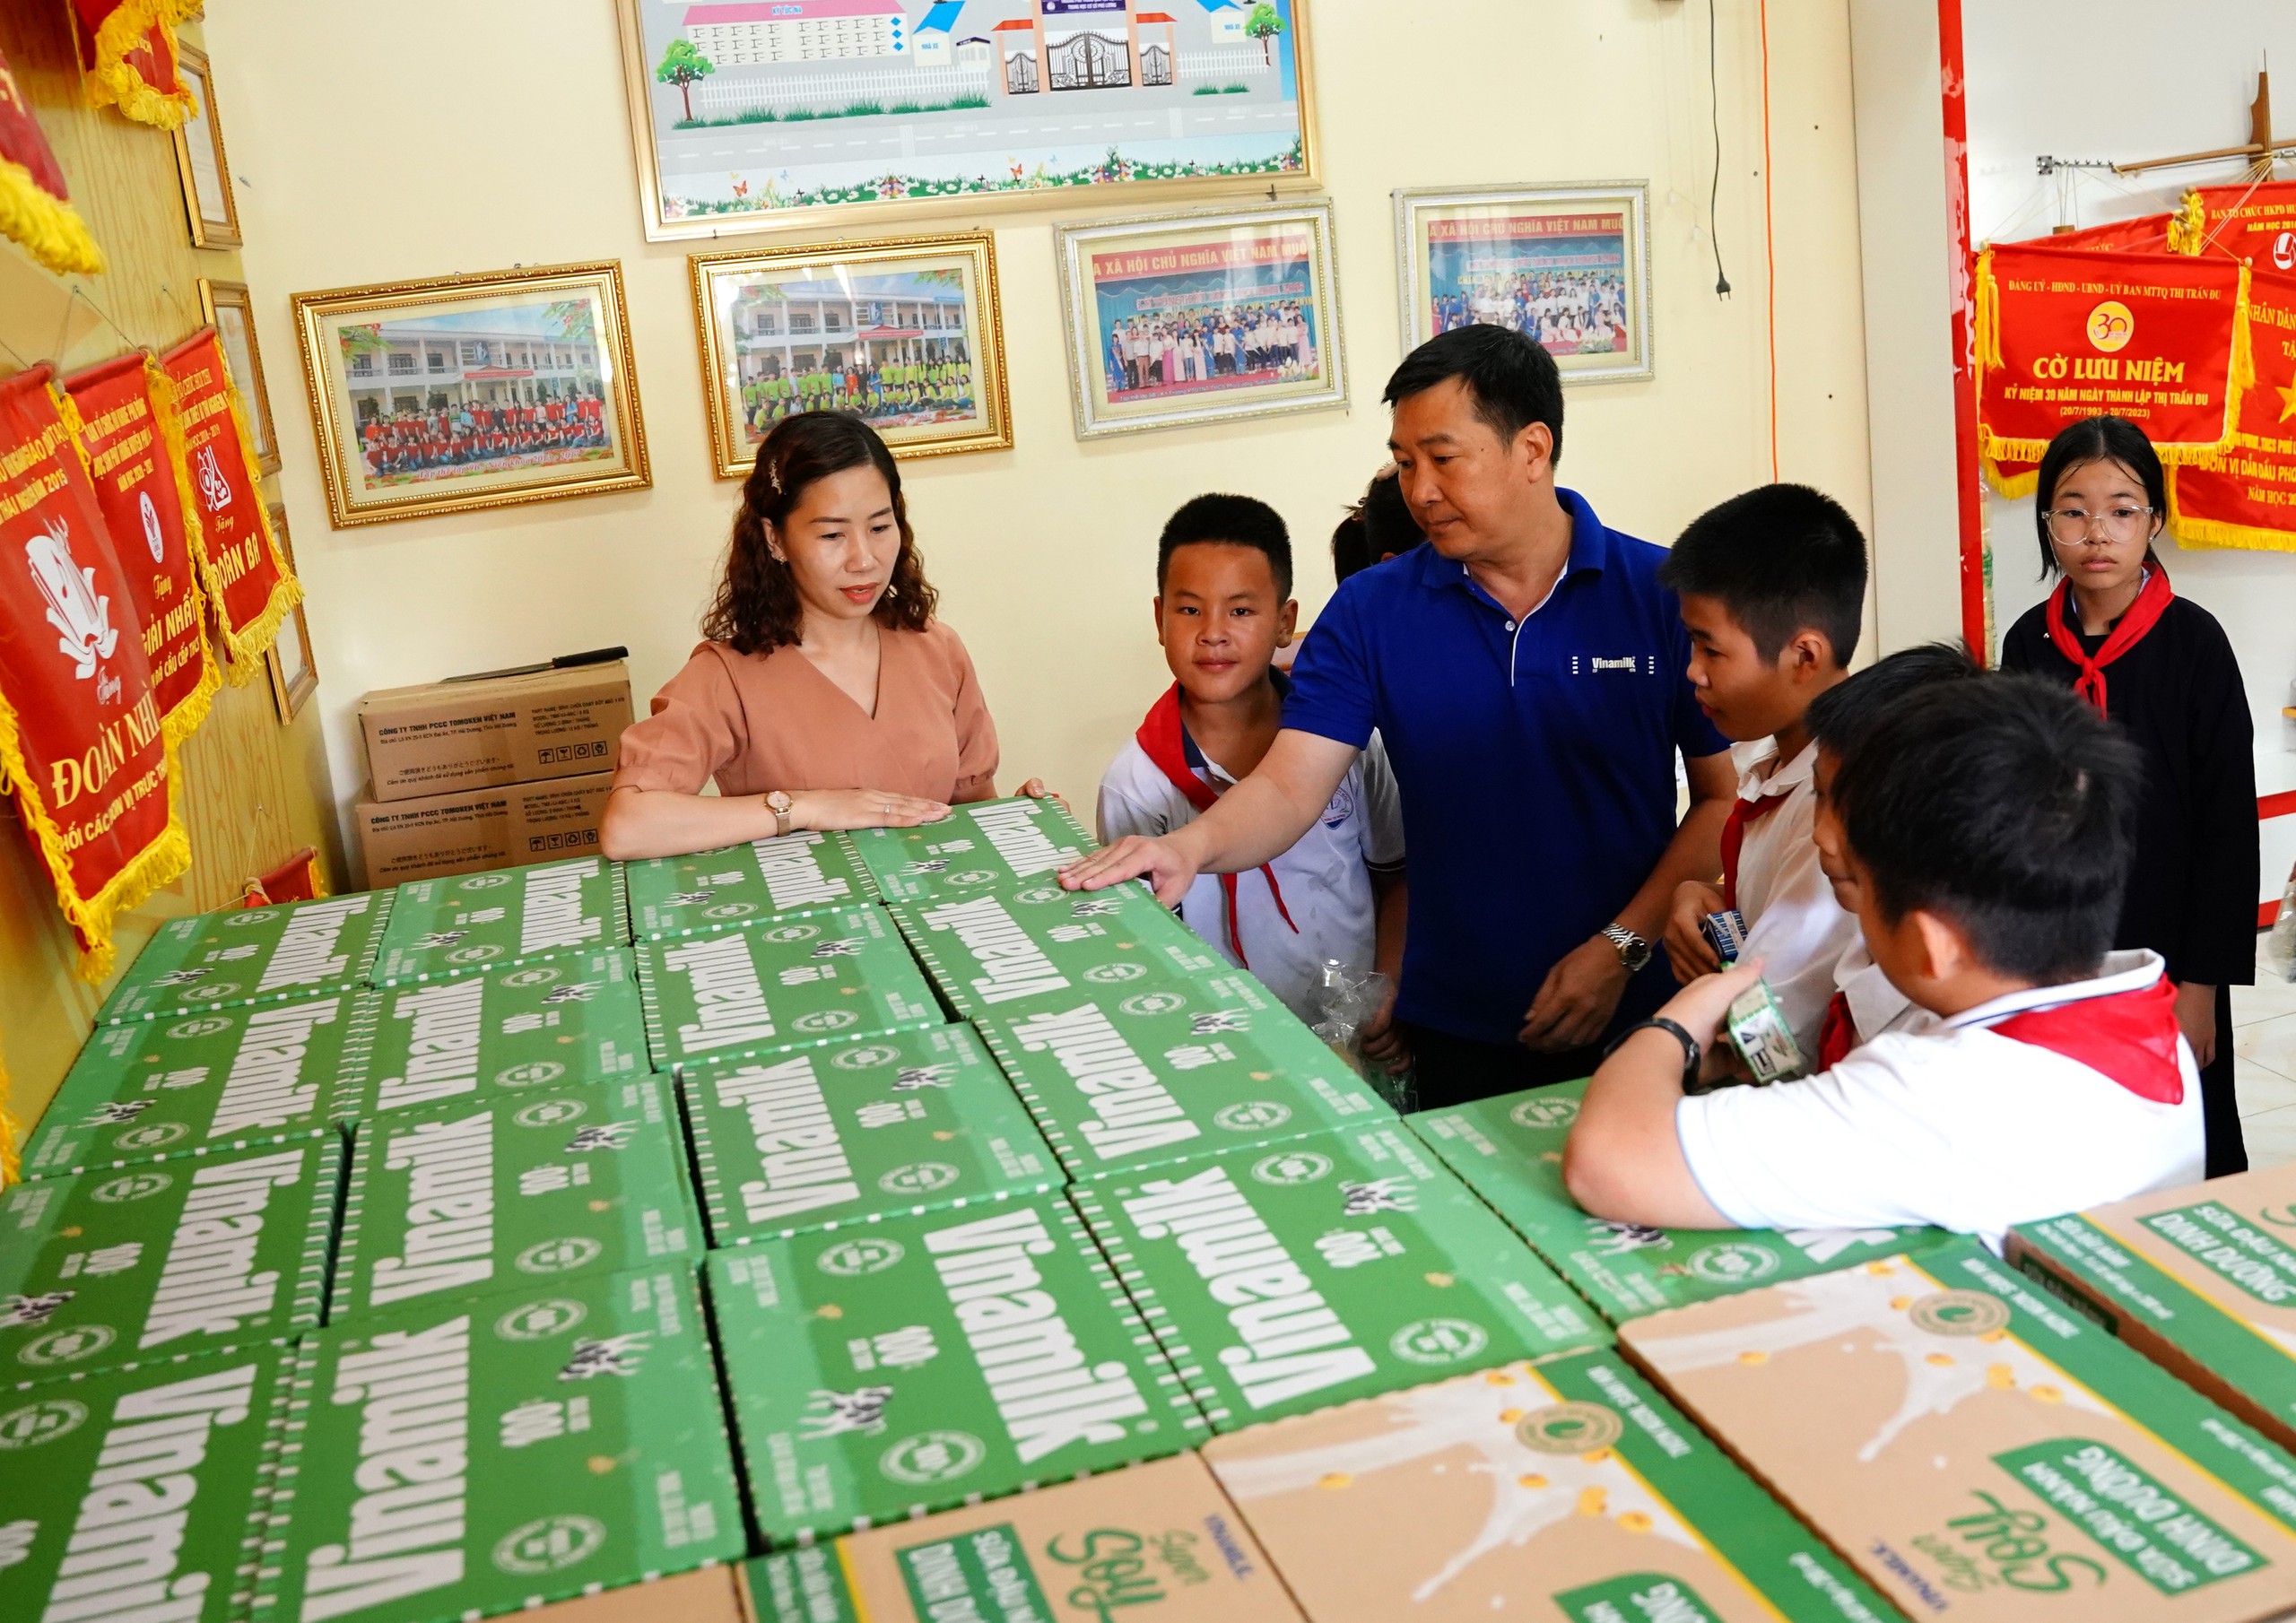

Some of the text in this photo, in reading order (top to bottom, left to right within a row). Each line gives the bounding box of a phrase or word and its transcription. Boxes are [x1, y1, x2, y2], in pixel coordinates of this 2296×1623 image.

[1441, 222, 1457, 237] XÃ
[1459, 221, 1479, 239] HỘI
[1483, 218, 1506, 235] CHỦ
[1509, 218, 1544, 233] NGHĨA
[1545, 218, 1570, 233] VIỆT
[1572, 218, 1598, 231] NAM
[2239, 204, 2263, 218] CHỨC
[1104, 257, 1123, 274] XÃ
[1126, 256, 1148, 273] HỘI
[1152, 250, 1178, 271] CHỦ
[1180, 249, 1218, 268] NGHĨA
[1222, 245, 1247, 265] VIỆT
[1251, 242, 1278, 260] NAM
[1282, 240, 1308, 258] MUÔ
[2008, 278, 2032, 291] ĐẢNG
[2051, 282, 2076, 292] HĐND
[2082, 282, 2104, 294] UBND
[2123, 284, 2143, 296] BAN
[2143, 286, 2168, 299] MTTQ
[2170, 287, 2185, 301] THỊ
[2186, 285, 2208, 299] TRẤN
[2005, 383, 2209, 407] KỶ NIỆM 30 NĂM NGÀY THÀNH LẬP THỊ TRẤN ĐU
[2032, 353, 2185, 386] CỜ LƯU NIỆM
[2060, 406, 2151, 420] (20/7/1993 20/7/2023)
[2229, 457, 2240, 480] VỊ
[2248, 485, 2287, 508] NĂM HỌC
[244, 531, 262, 571] BA
[1592, 656, 1636, 670] Vinamilk
[50, 680, 161, 810] ĐOÀN NHÌ
[378, 711, 517, 736] CÔNG TY TNHH PCCC TOMOKEN VIỆT NAM
[59, 820, 83, 853] HỐI
[84, 812, 109, 842] CÁC
[370, 815, 390, 825] CÔNG
[391, 814, 399, 822] TY
[401, 812, 420, 820] TNHH
[421, 810, 439, 819] PCCC
[474, 803, 490, 812] VIỆT
[491, 800, 507, 809] NAM
[967, 799, 1084, 878] Vinamilk
[257, 895, 371, 993] Vinamilk
[519, 859, 602, 955] Vinamilk
[922, 895, 1073, 1005] Vinamilk
[664, 933, 777, 1055] Vinamilk
[207, 998, 341, 1139] Vinamilk
[377, 976, 484, 1111] Vinamilk
[1011, 1002, 1202, 1161] Vinamilk
[716, 1055, 862, 1225] Vinamilk
[370, 1111, 494, 1306] Vinamilk
[2193, 1205, 2272, 1256] SỮA ĐẬU
[139, 1150, 304, 1350] Vinamilk
[1120, 1165, 1378, 1410] Vinamilk
[2149, 1212, 2223, 1253] DINH
[2201, 1245, 2295, 1302] DƯỠNG
[923, 1207, 1148, 1464] Vinamilk
[41, 1364, 257, 1623] Vinamil
[300, 1315, 470, 1623] Vinamilk
[2062, 1444, 2180, 1523] DƯỠNG
[972, 1530, 1017, 1571] SỮA
[1945, 1488, 2108, 1593] Soy
[2022, 1461, 2198, 1589] SỮA ĐẬU NÀNH
[2154, 1512, 2254, 1576] DINH
[907, 1541, 972, 1601] DINH
